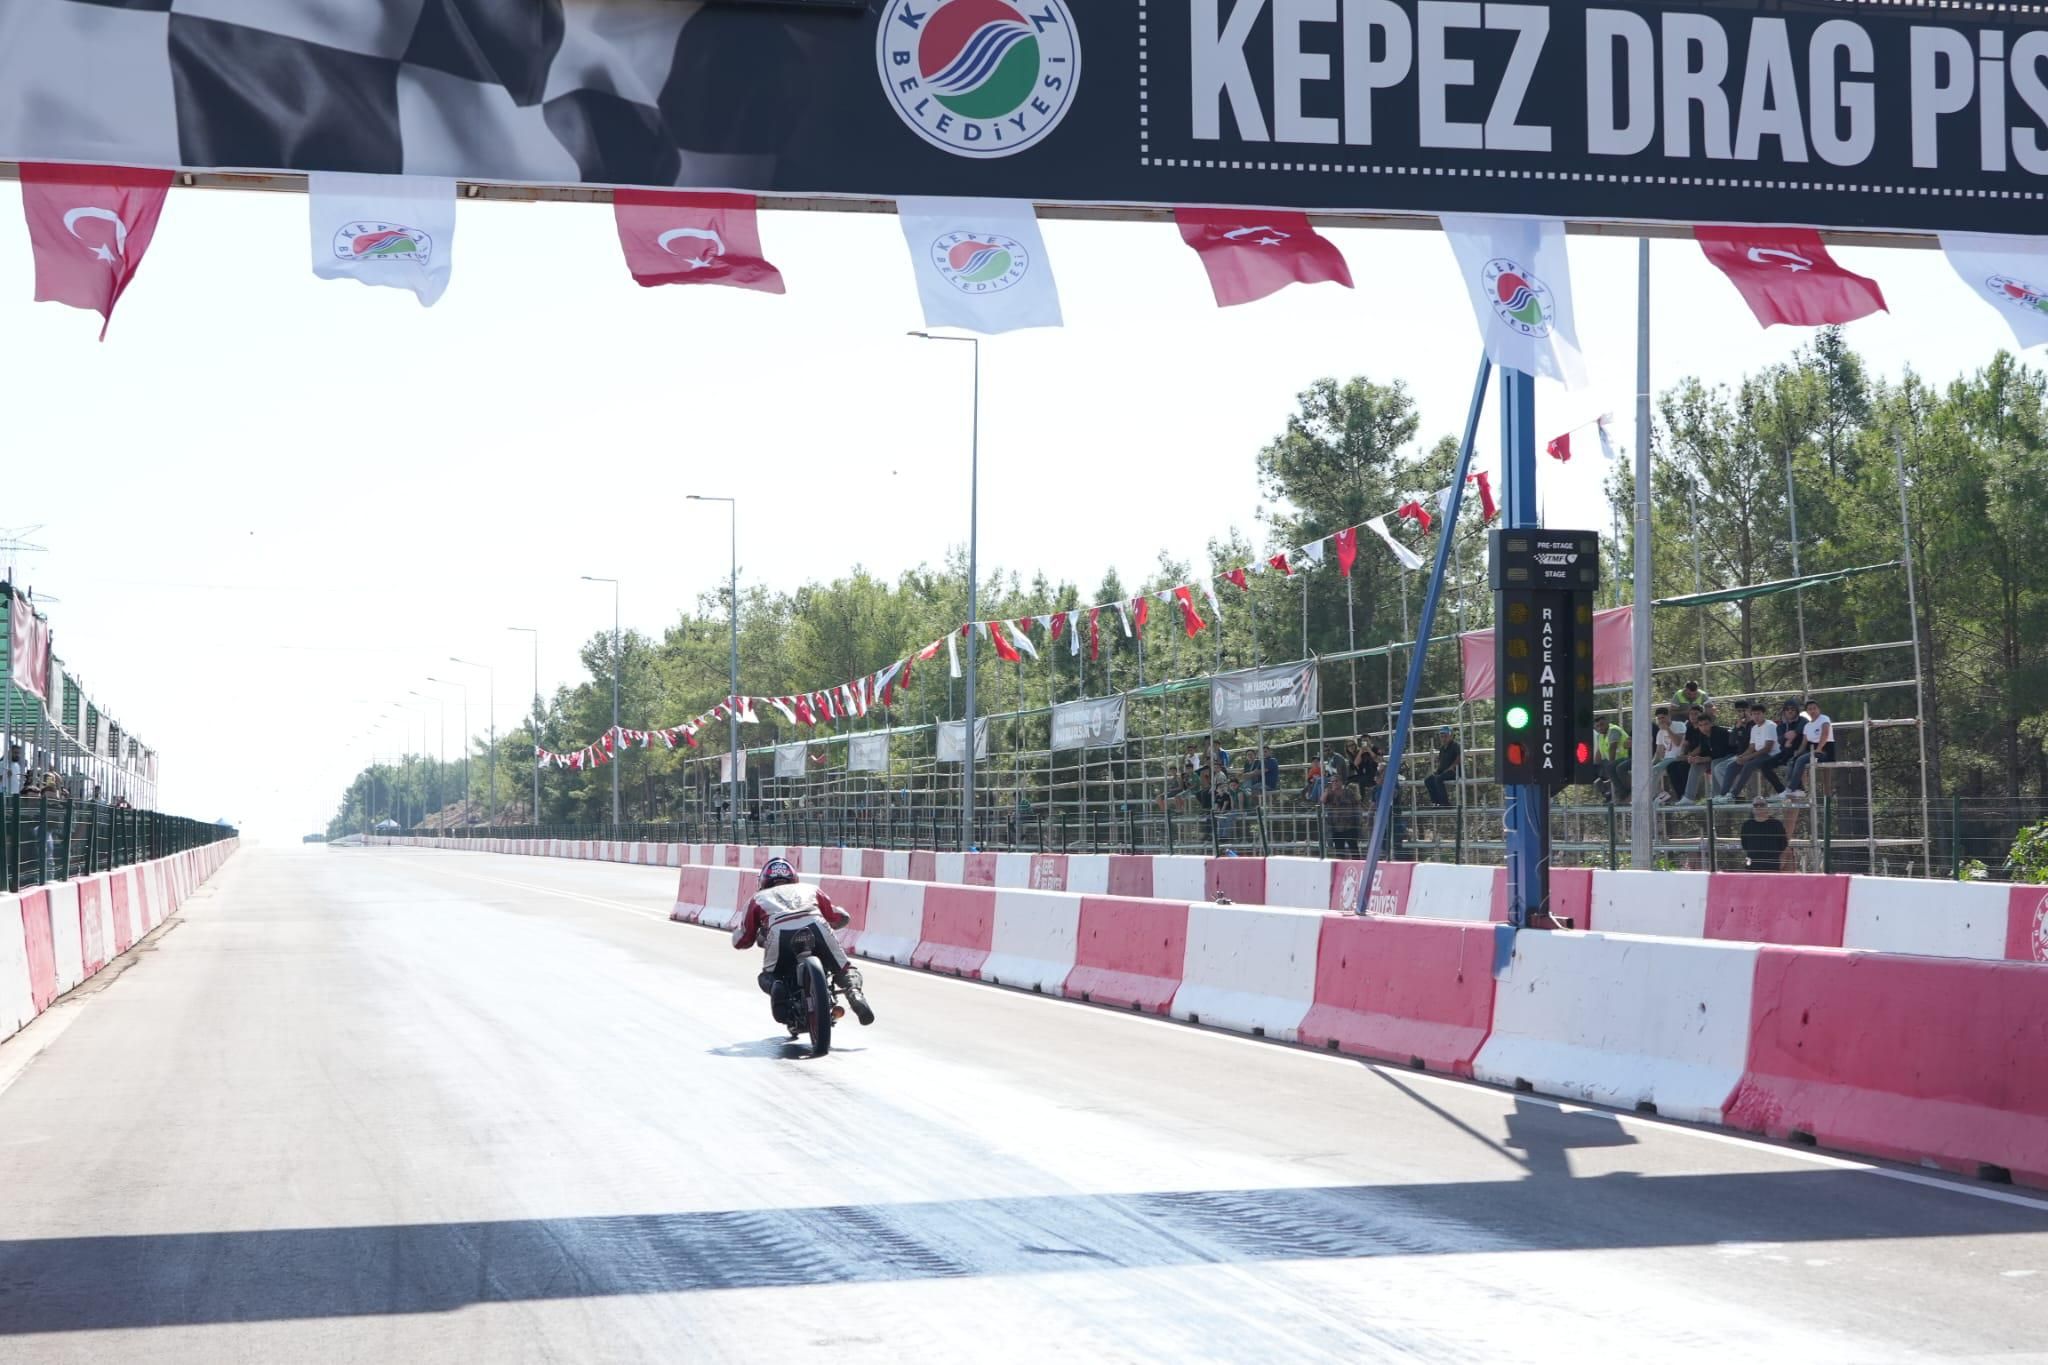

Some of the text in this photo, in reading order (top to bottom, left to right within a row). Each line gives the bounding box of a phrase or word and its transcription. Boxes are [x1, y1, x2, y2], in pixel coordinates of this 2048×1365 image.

[1190, 0, 1553, 153] KEPEZ
[1585, 8, 1876, 167] DRAG
[1544, 570, 1566, 578] STAGE
